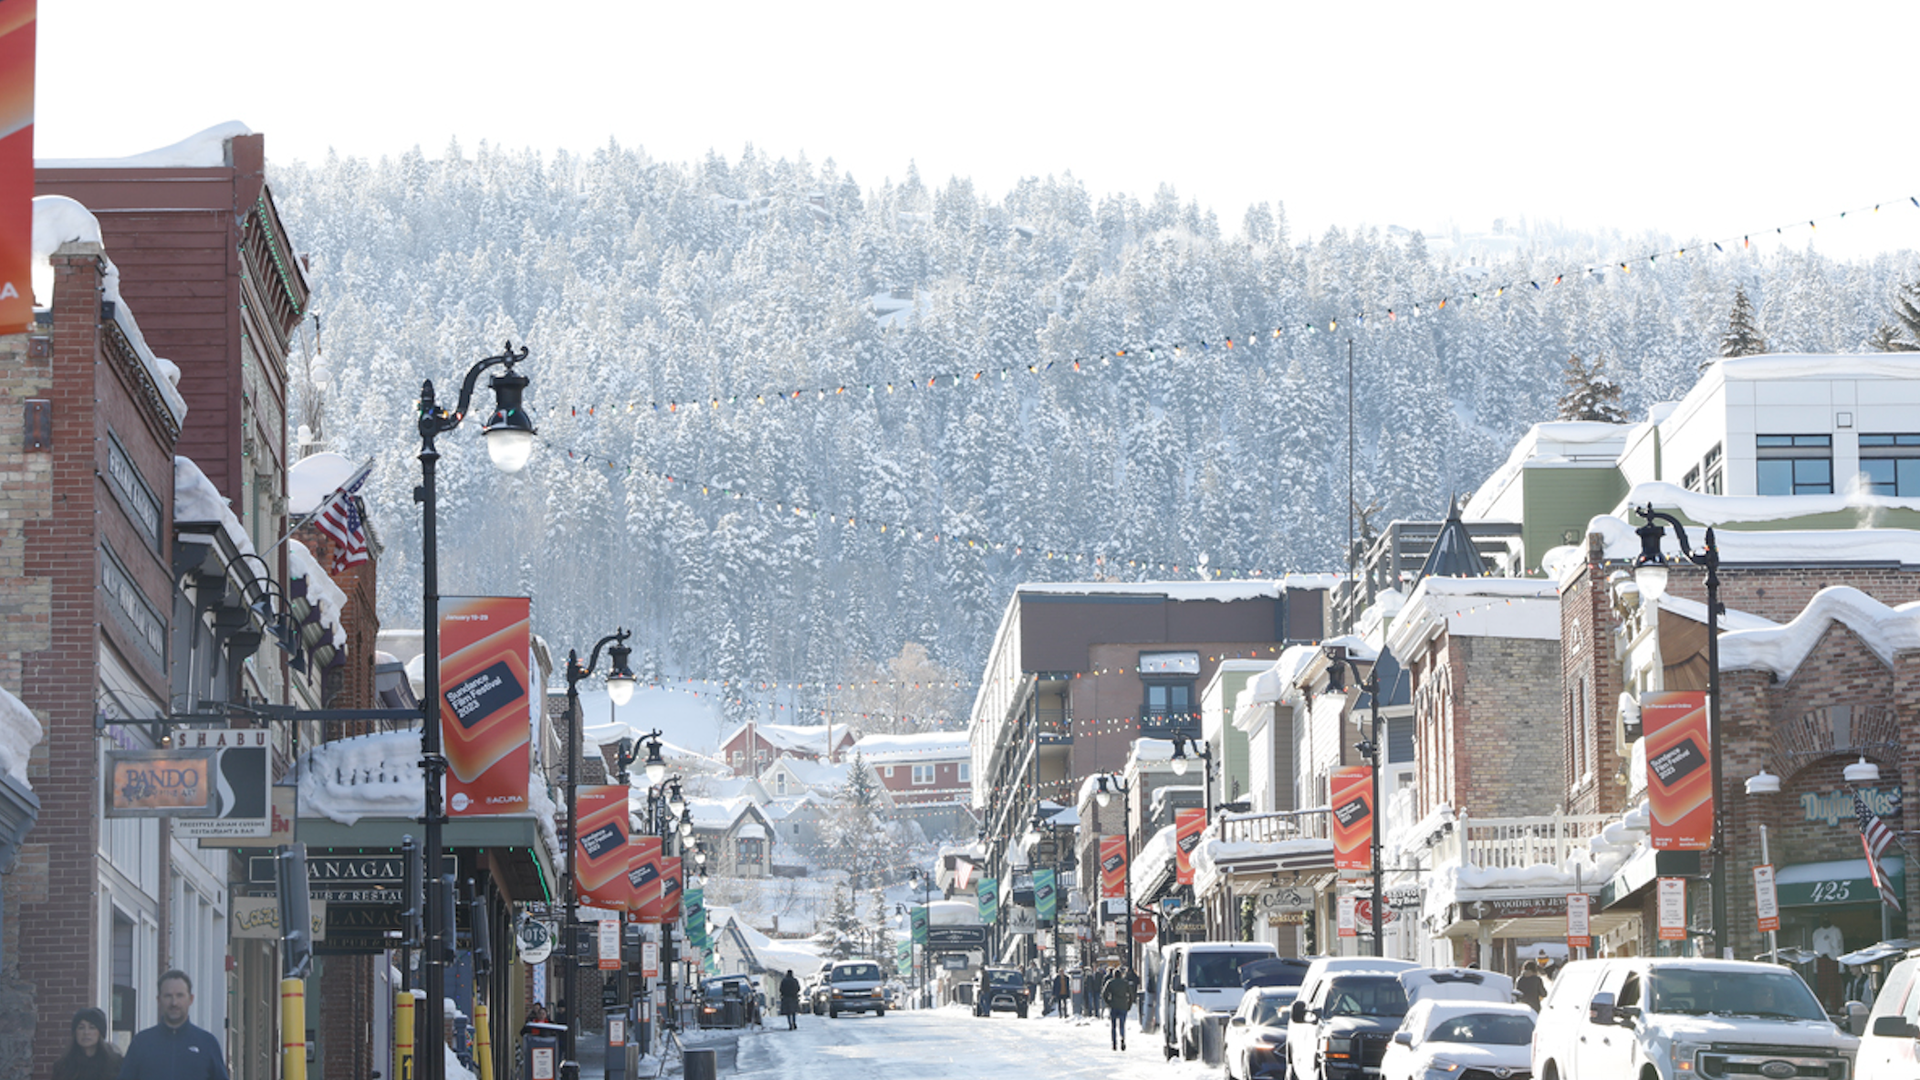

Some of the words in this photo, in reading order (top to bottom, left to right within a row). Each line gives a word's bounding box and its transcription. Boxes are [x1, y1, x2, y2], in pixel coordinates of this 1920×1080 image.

[0, 282, 19, 300] A
[445, 614, 470, 622] January
[446, 674, 489, 702] Sundance
[451, 694, 473, 710] Film
[469, 675, 503, 698] Festival
[456, 700, 480, 719] 2023
[179, 733, 265, 746] SHABU
[1650, 747, 1681, 768] Sundance
[1655, 763, 1670, 774] Film
[1668, 749, 1691, 767] Festival
[126, 768, 199, 789] PANDO
[1659, 767, 1676, 780] 2023
[181, 788, 196, 797] ART
[492, 795, 524, 804] ACURA
[1810, 880, 1852, 902] 425
[1493, 897, 1547, 909] WOODBURY
